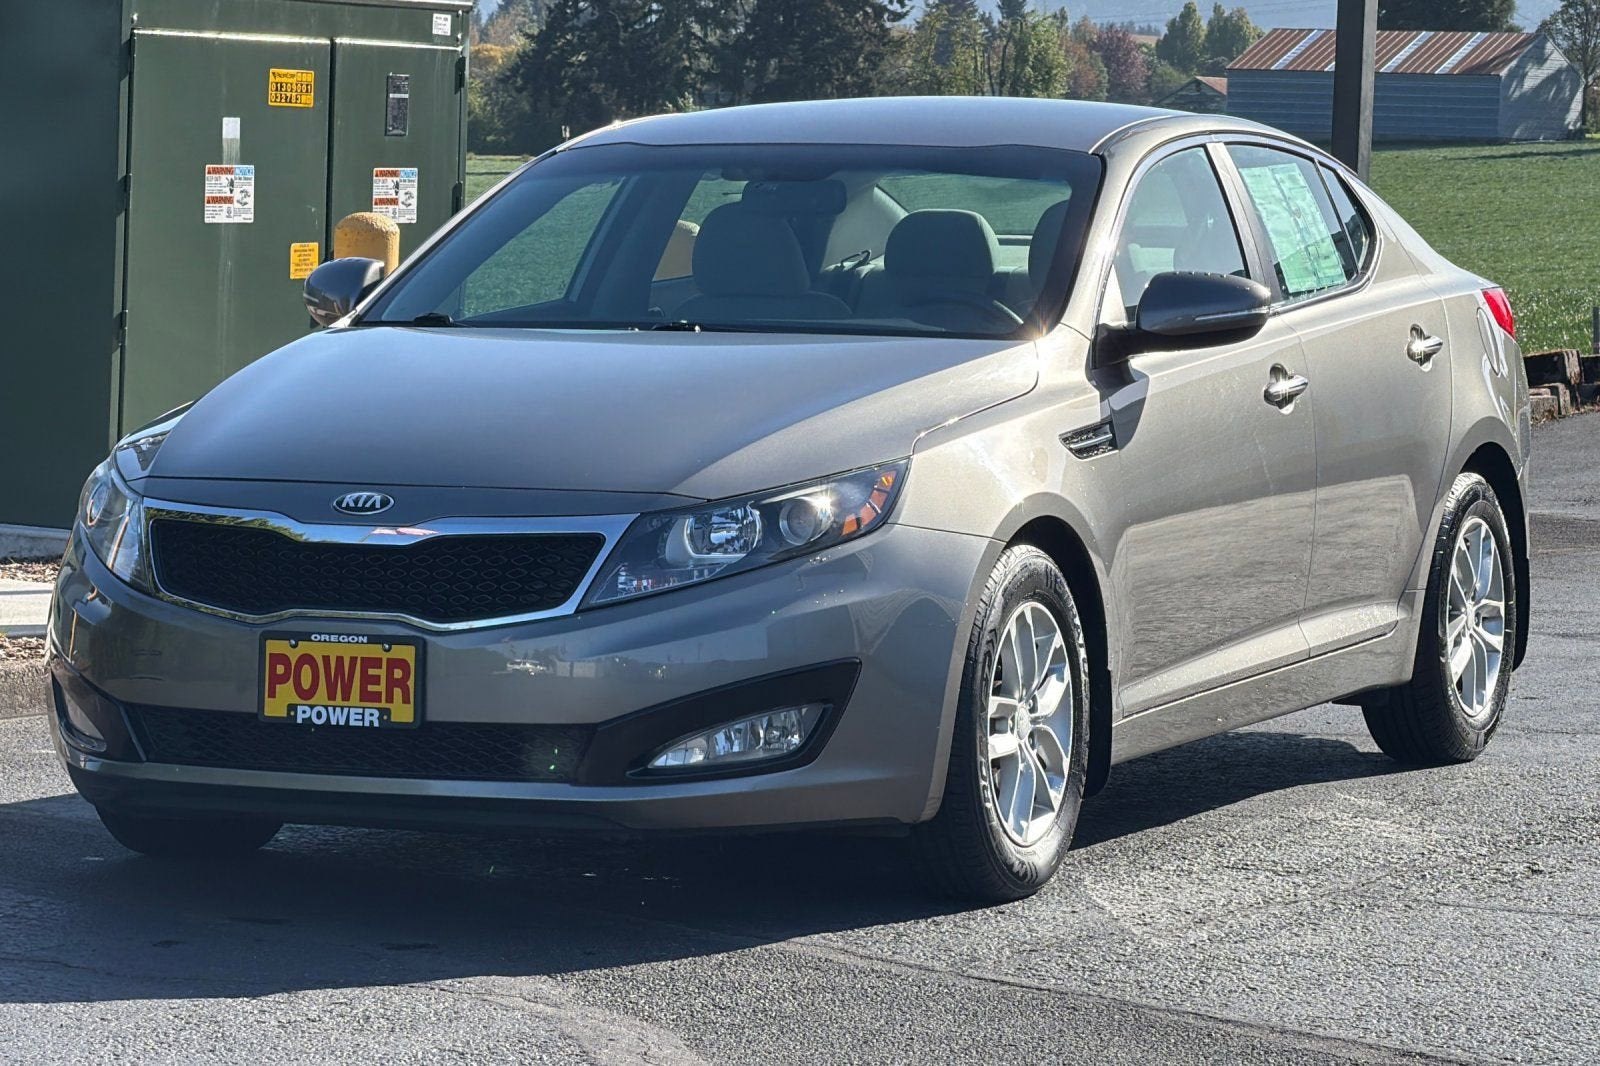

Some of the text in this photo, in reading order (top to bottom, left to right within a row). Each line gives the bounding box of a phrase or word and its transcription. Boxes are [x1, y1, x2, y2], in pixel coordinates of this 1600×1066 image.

[271, 82, 312, 93] 01309001
[270, 93, 301, 103] 032783
[211, 167, 234, 175] WARNING
[235, 167, 254, 175] NOTICE
[400, 170, 417, 178] NOTICE
[210, 196, 233, 204] WARNING
[341, 494, 381, 509] KIA
[311, 634, 368, 643] OREGON
[267, 652, 411, 704] POWER
[296, 705, 380, 727] POWER
